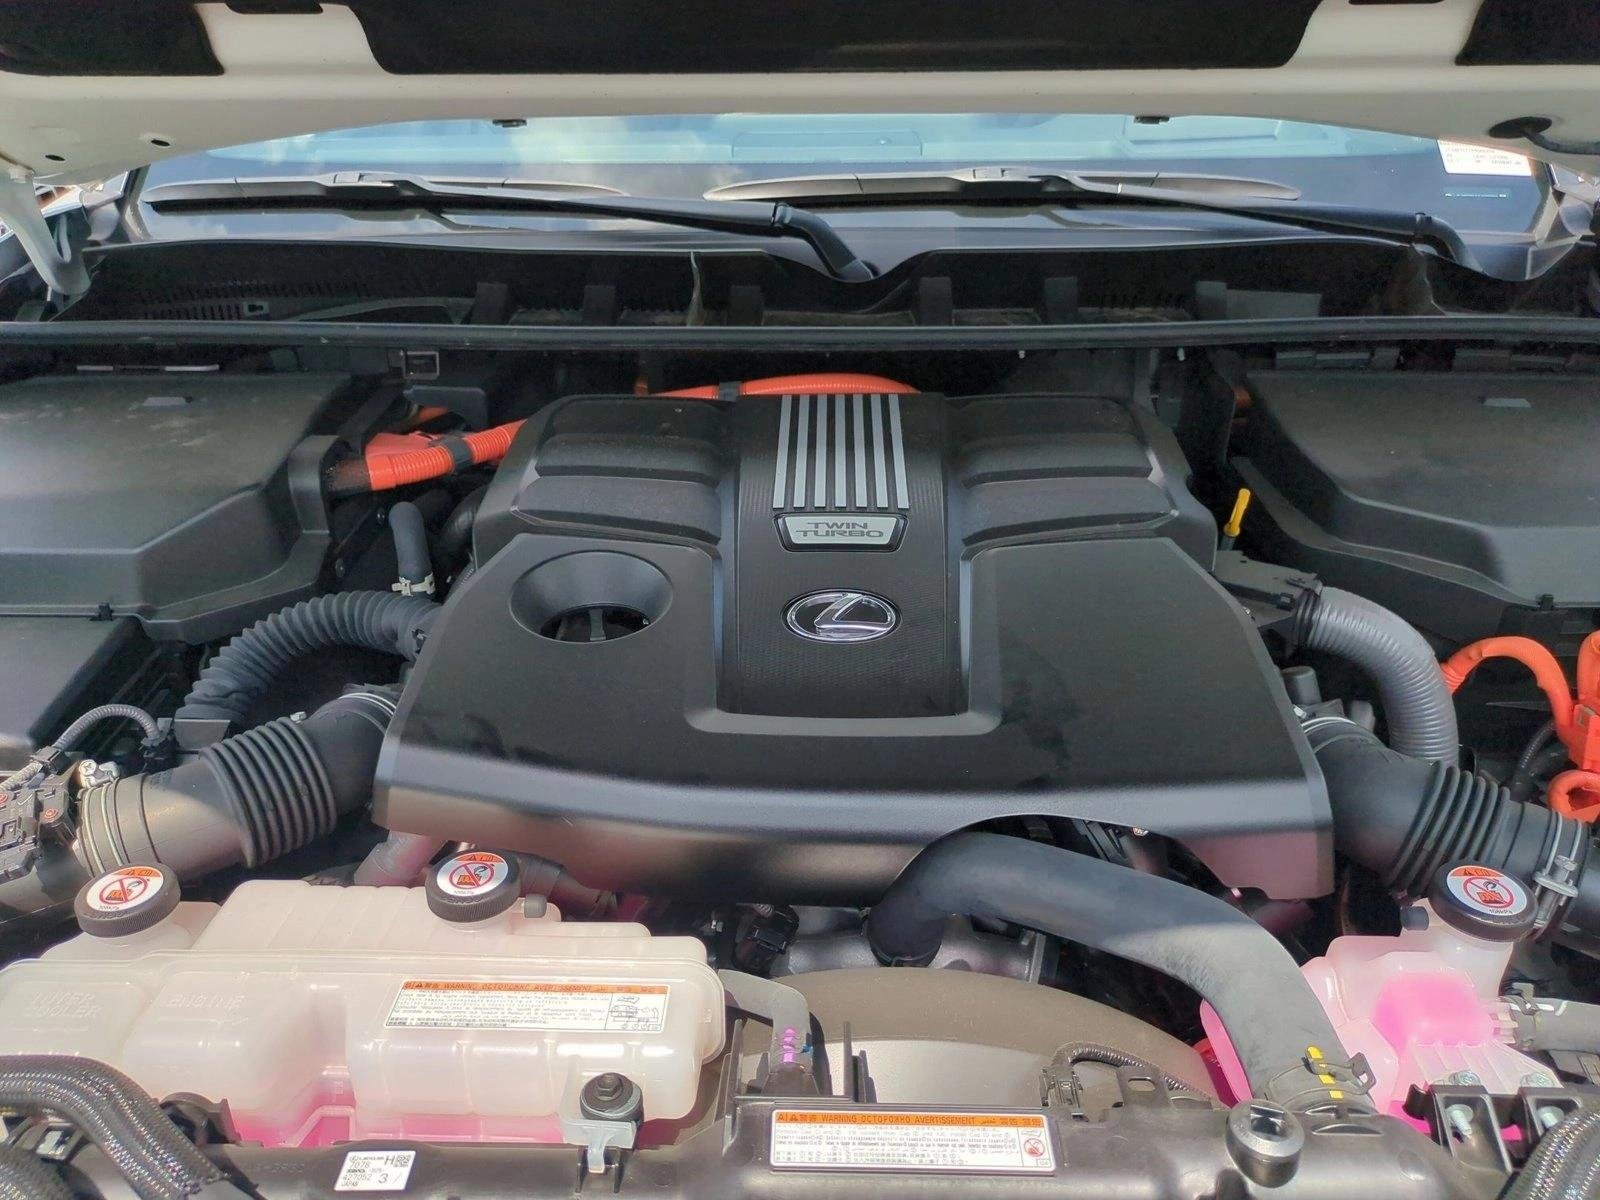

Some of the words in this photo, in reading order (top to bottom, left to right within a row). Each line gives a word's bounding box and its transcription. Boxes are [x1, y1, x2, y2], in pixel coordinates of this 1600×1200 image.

[806, 522, 868, 530] TWIN
[795, 529, 884, 538] TURBO
[821, 1114, 857, 1123] WARNING
[914, 1116, 976, 1125] AVERTISSEMENT
[378, 1173, 389, 1184] 3
